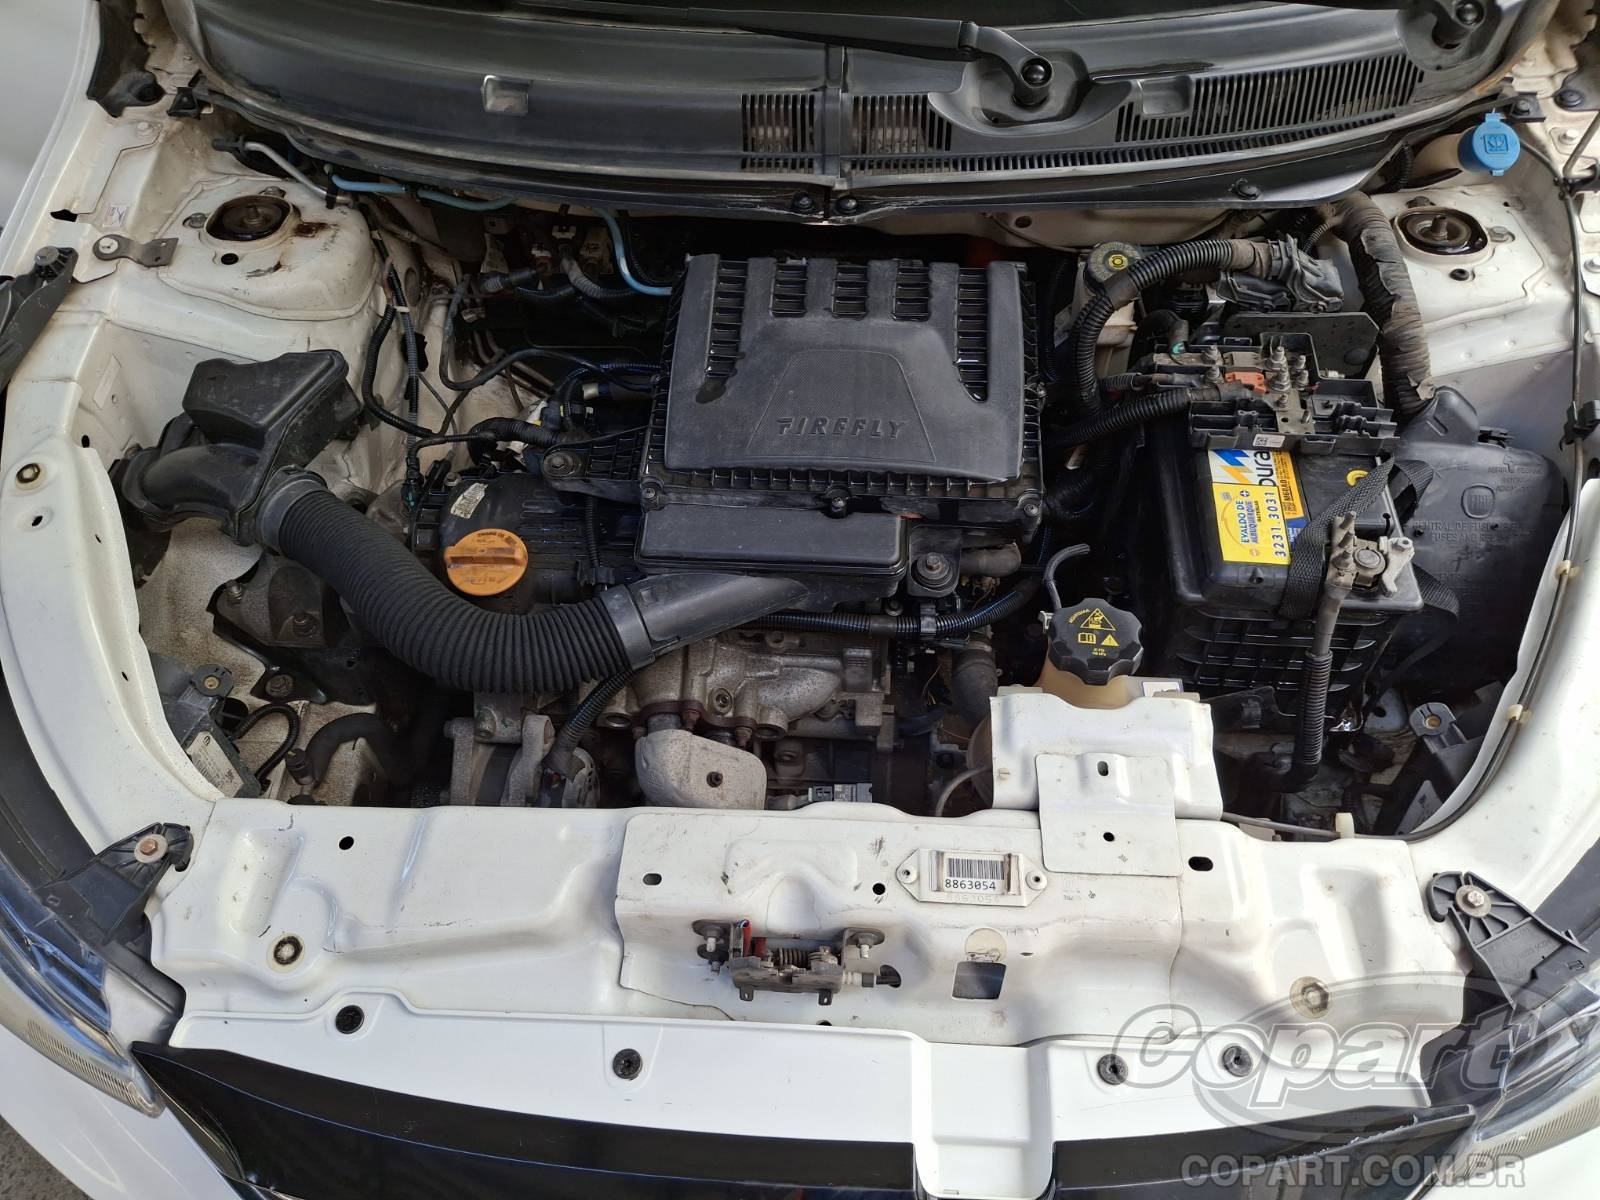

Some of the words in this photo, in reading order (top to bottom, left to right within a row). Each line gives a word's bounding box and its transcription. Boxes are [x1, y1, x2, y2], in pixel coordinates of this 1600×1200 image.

[777, 417, 906, 439] FIREFLY
[1236, 500, 1245, 510] DE
[1238, 512, 1249, 543] EVALDO
[1265, 492, 1286, 557] 3231.3031
[945, 878, 997, 891] 8863054
